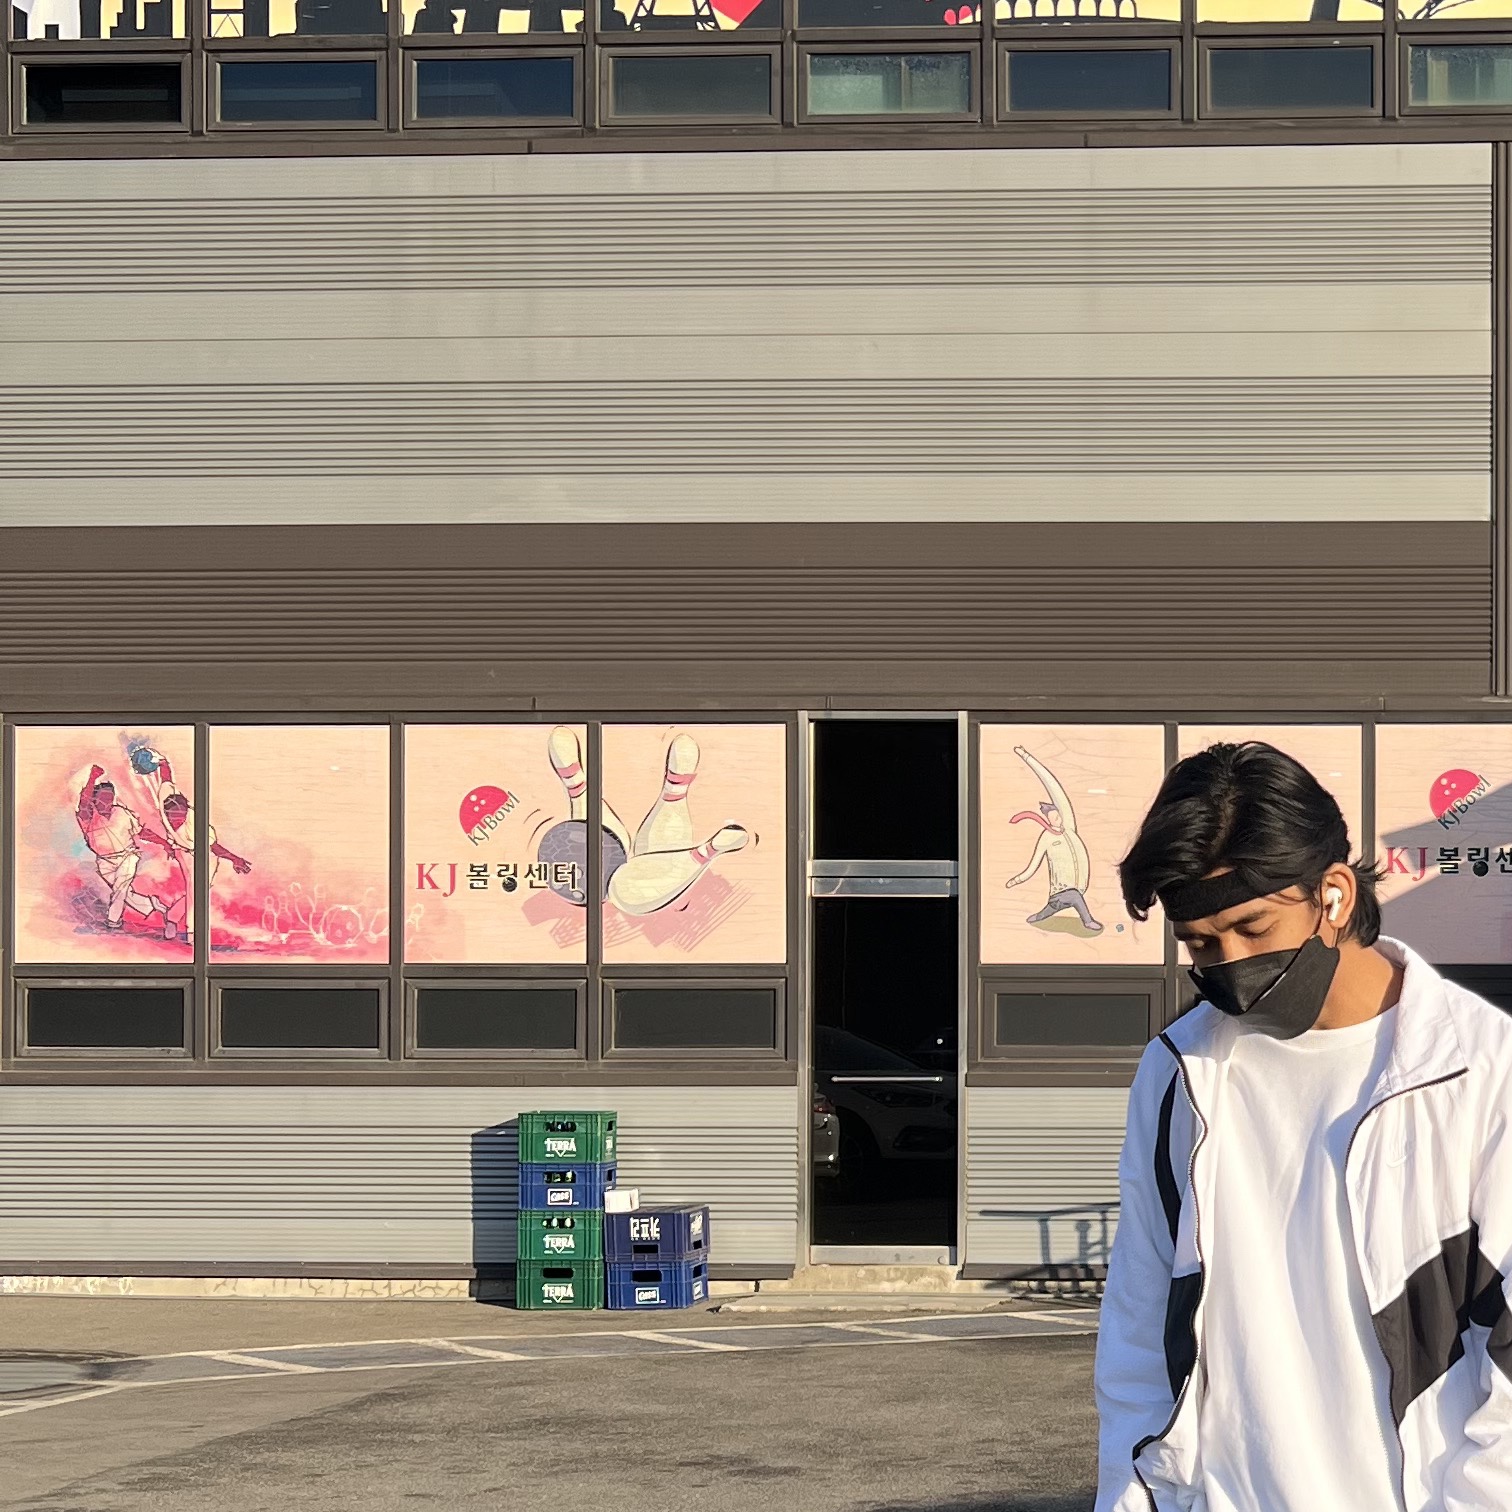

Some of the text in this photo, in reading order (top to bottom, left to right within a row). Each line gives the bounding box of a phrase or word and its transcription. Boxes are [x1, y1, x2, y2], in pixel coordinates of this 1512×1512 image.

[467, 791, 520, 847] KJ Bowl
[1437, 774, 1491, 830] KJ Bowl
[416, 863, 578, 897] KJ 볼링센터
[1385, 847, 1428, 881] KJ
[544, 1138, 577, 1152] TERRA
[543, 1234, 575, 1248] TERRA
[542, 1283, 574, 1297] TERRA
